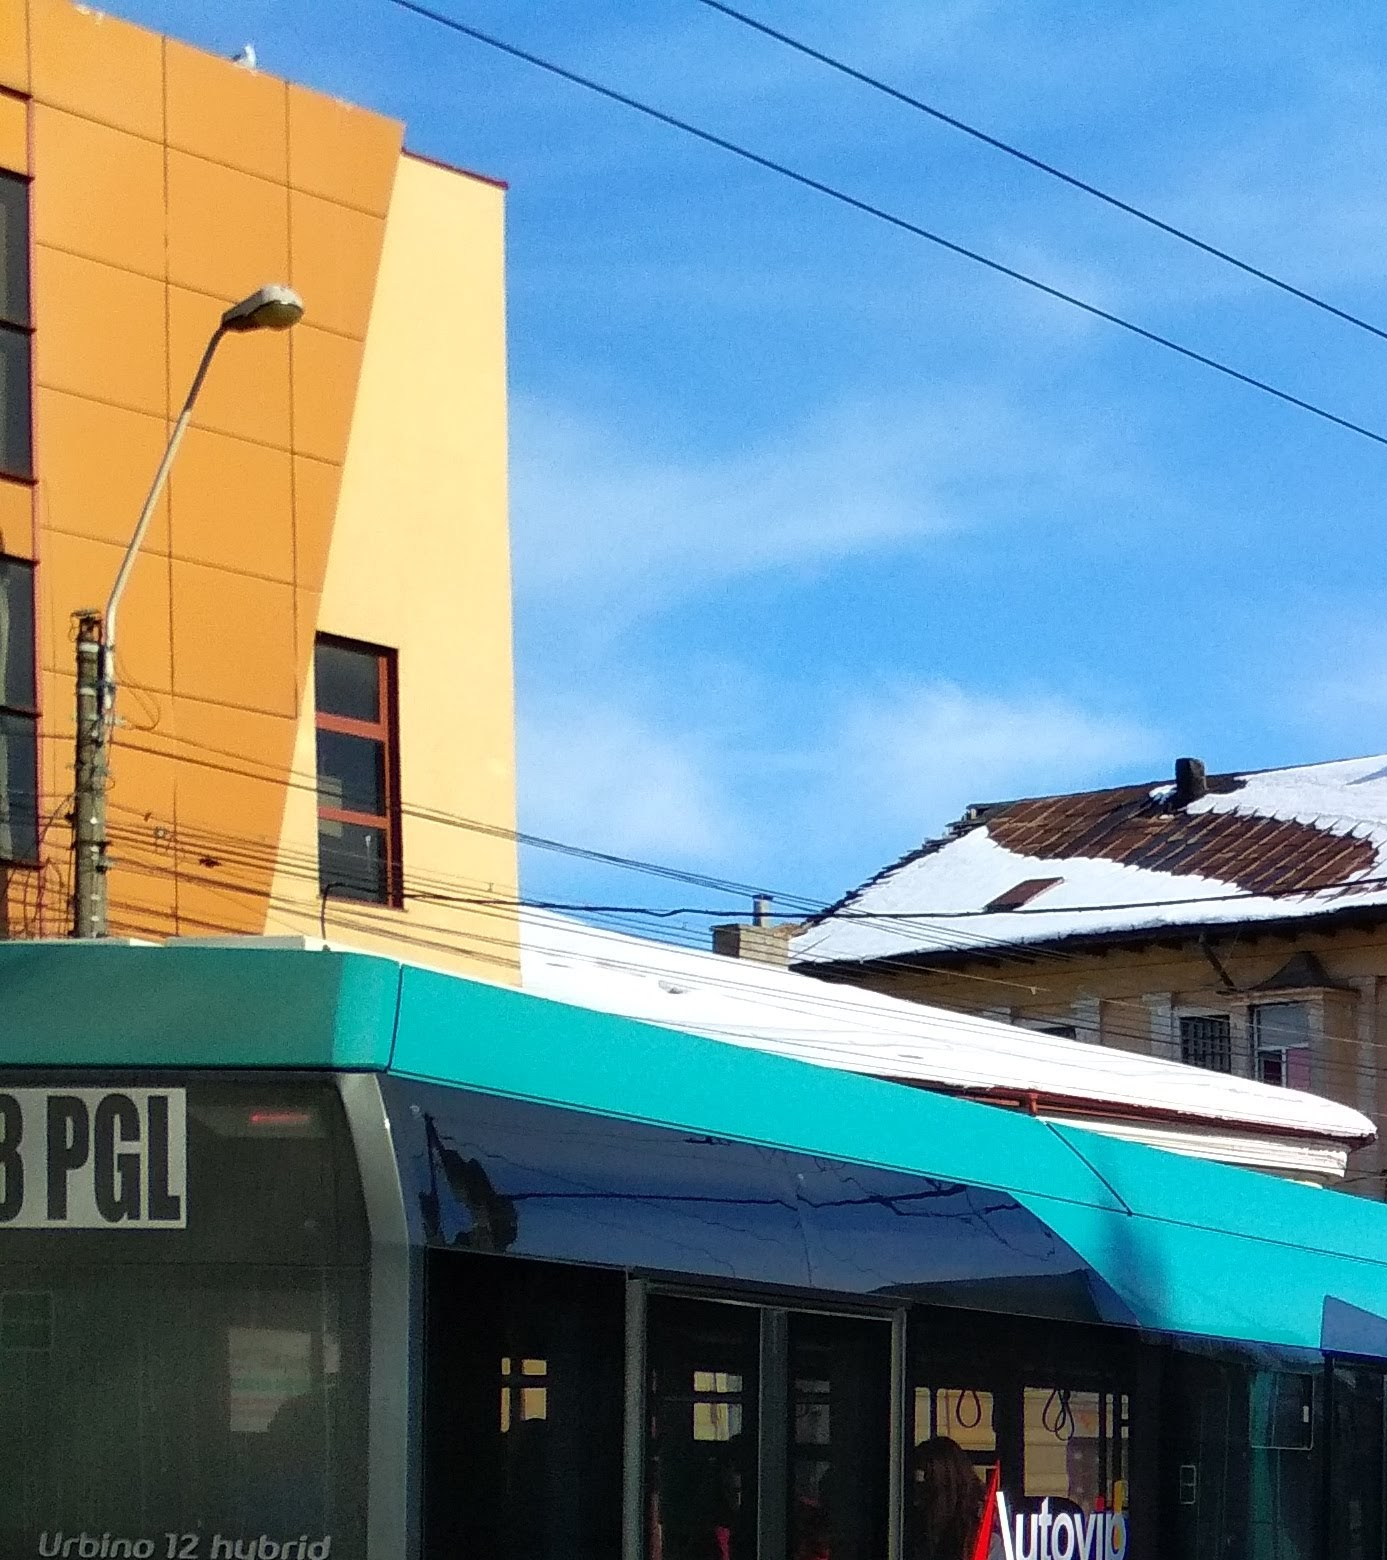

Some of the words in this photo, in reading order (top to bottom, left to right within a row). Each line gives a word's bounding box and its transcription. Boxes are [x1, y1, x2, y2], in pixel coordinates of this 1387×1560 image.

[47, 1093, 181, 1223] PGL
[38, 1530, 154, 1560] Urbino
[164, 1532, 200, 1560] 12
